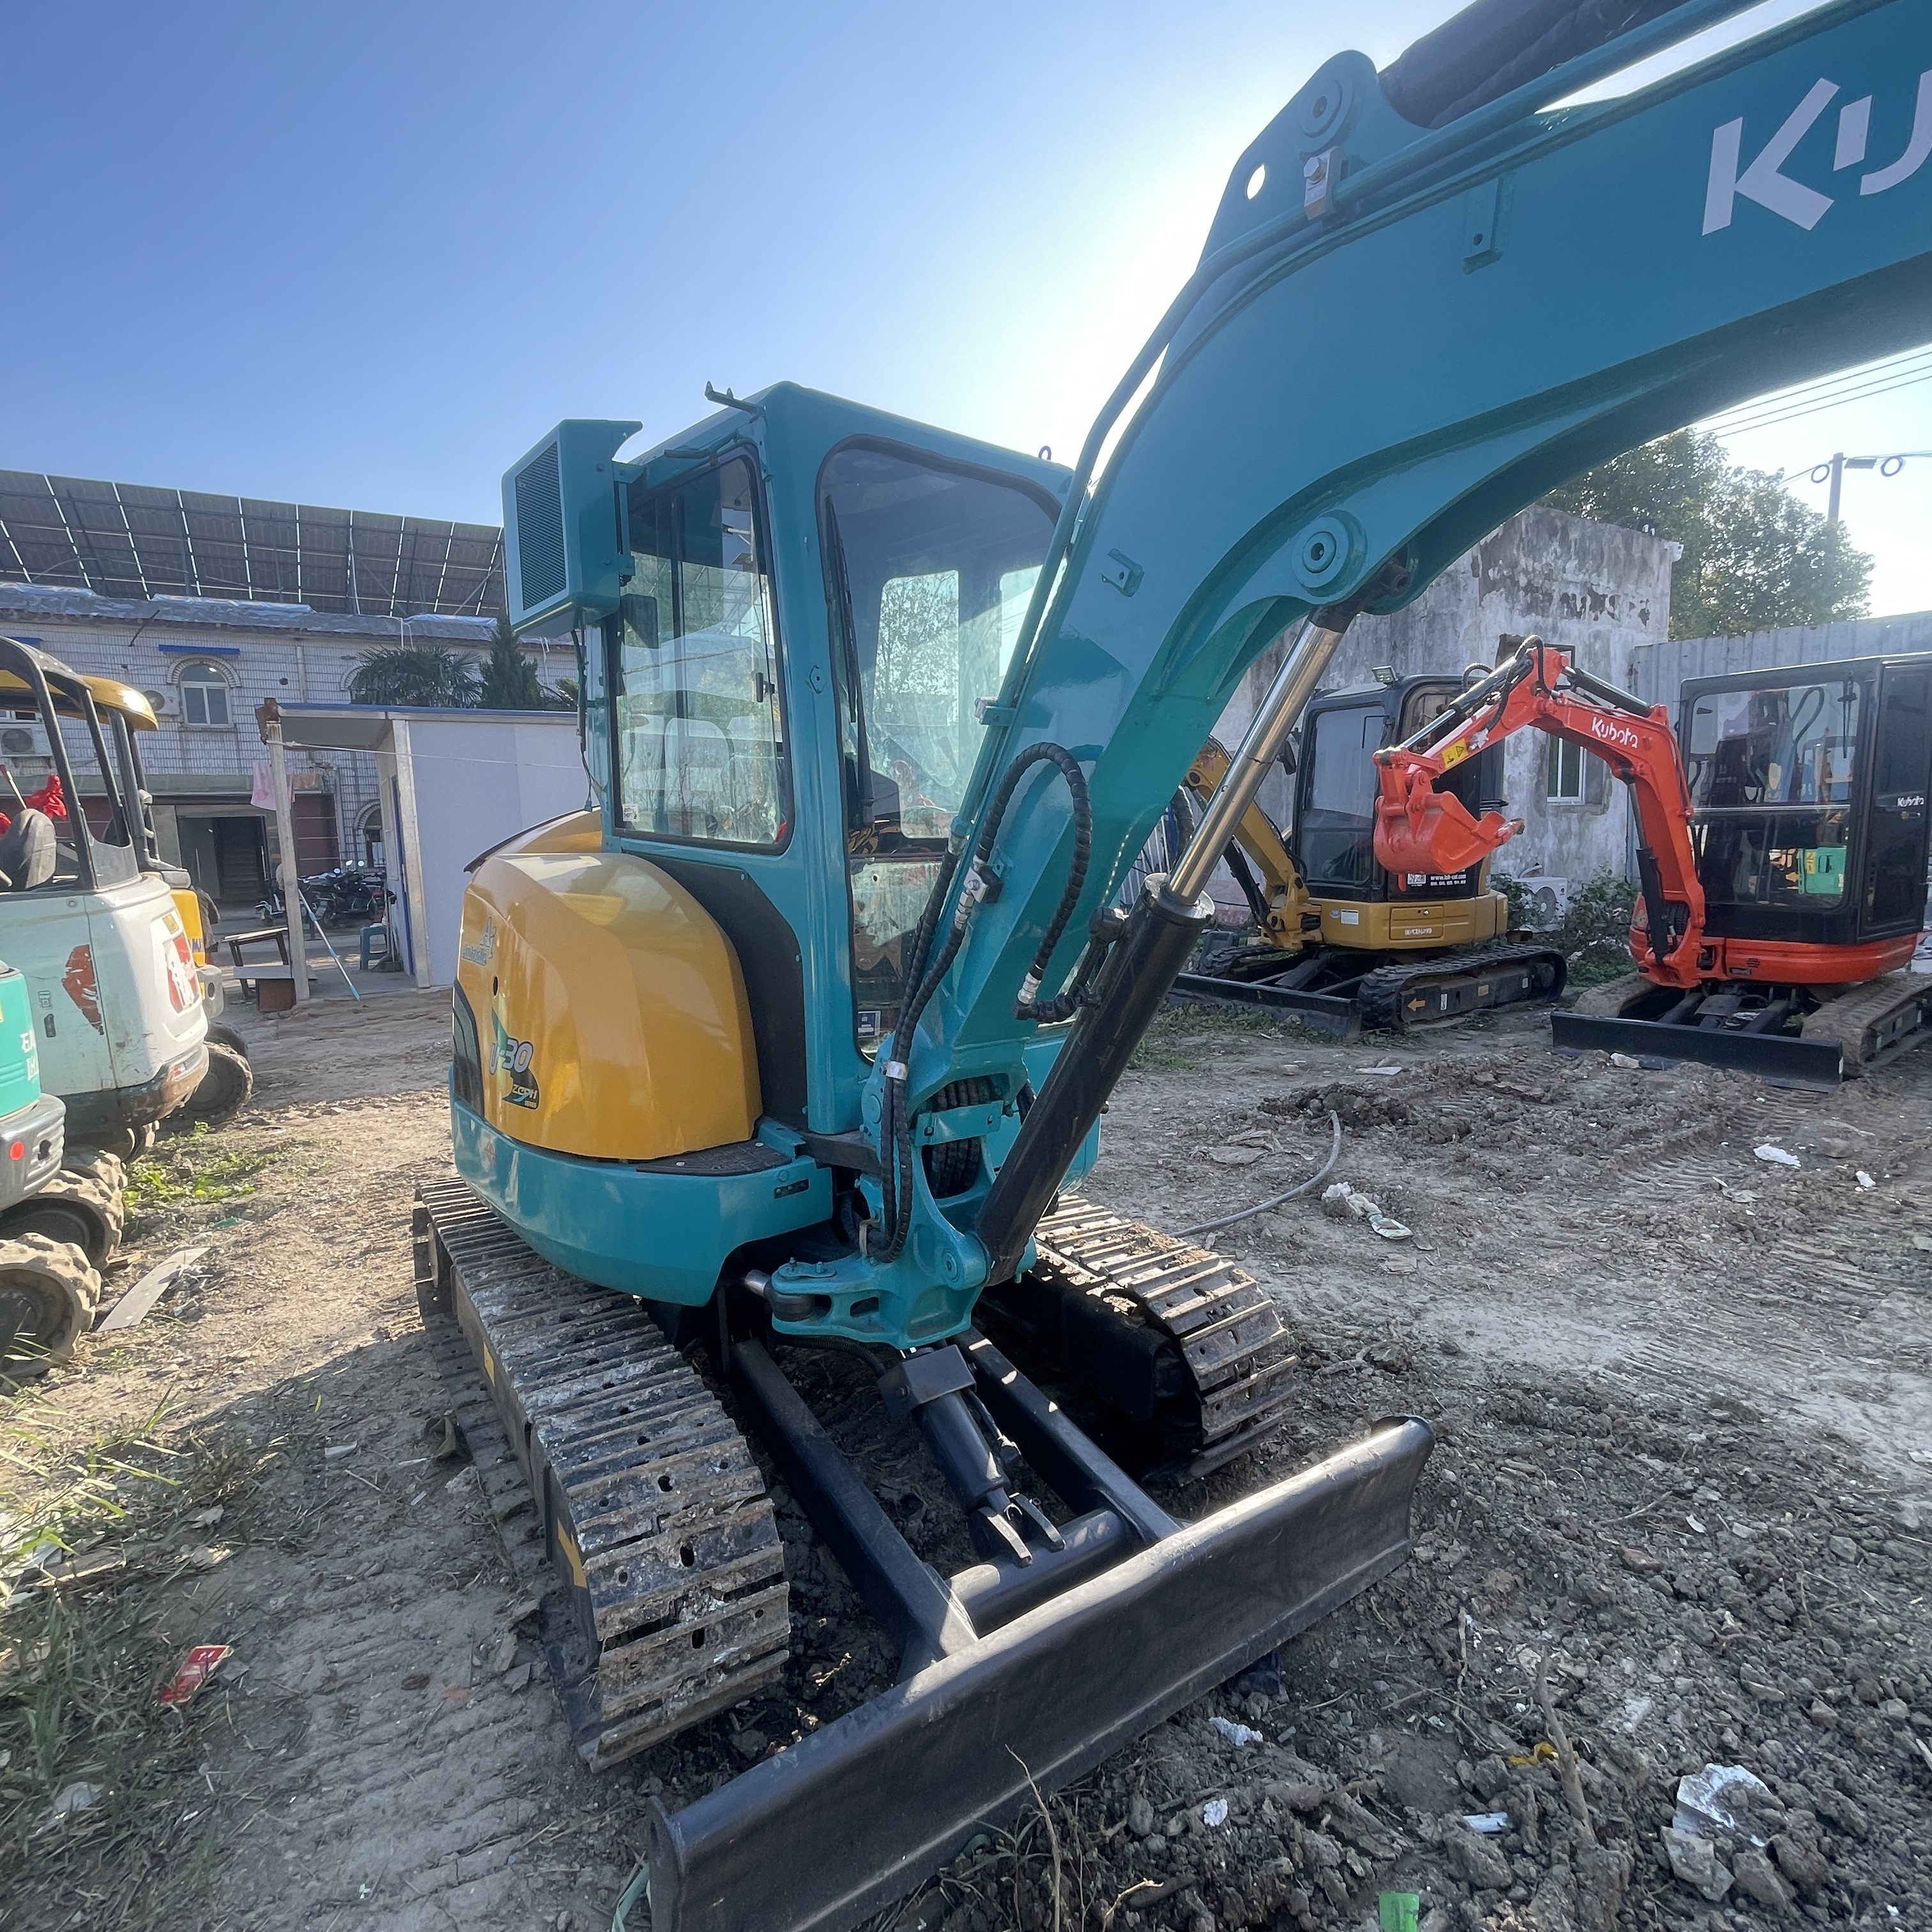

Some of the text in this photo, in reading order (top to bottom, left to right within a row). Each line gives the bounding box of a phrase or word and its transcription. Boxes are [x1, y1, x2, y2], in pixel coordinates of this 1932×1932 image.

[1591, 716, 1638, 749] Kubota
[1897, 795, 1924, 807] Kubota
[489, 1036, 535, 1076] U-30
